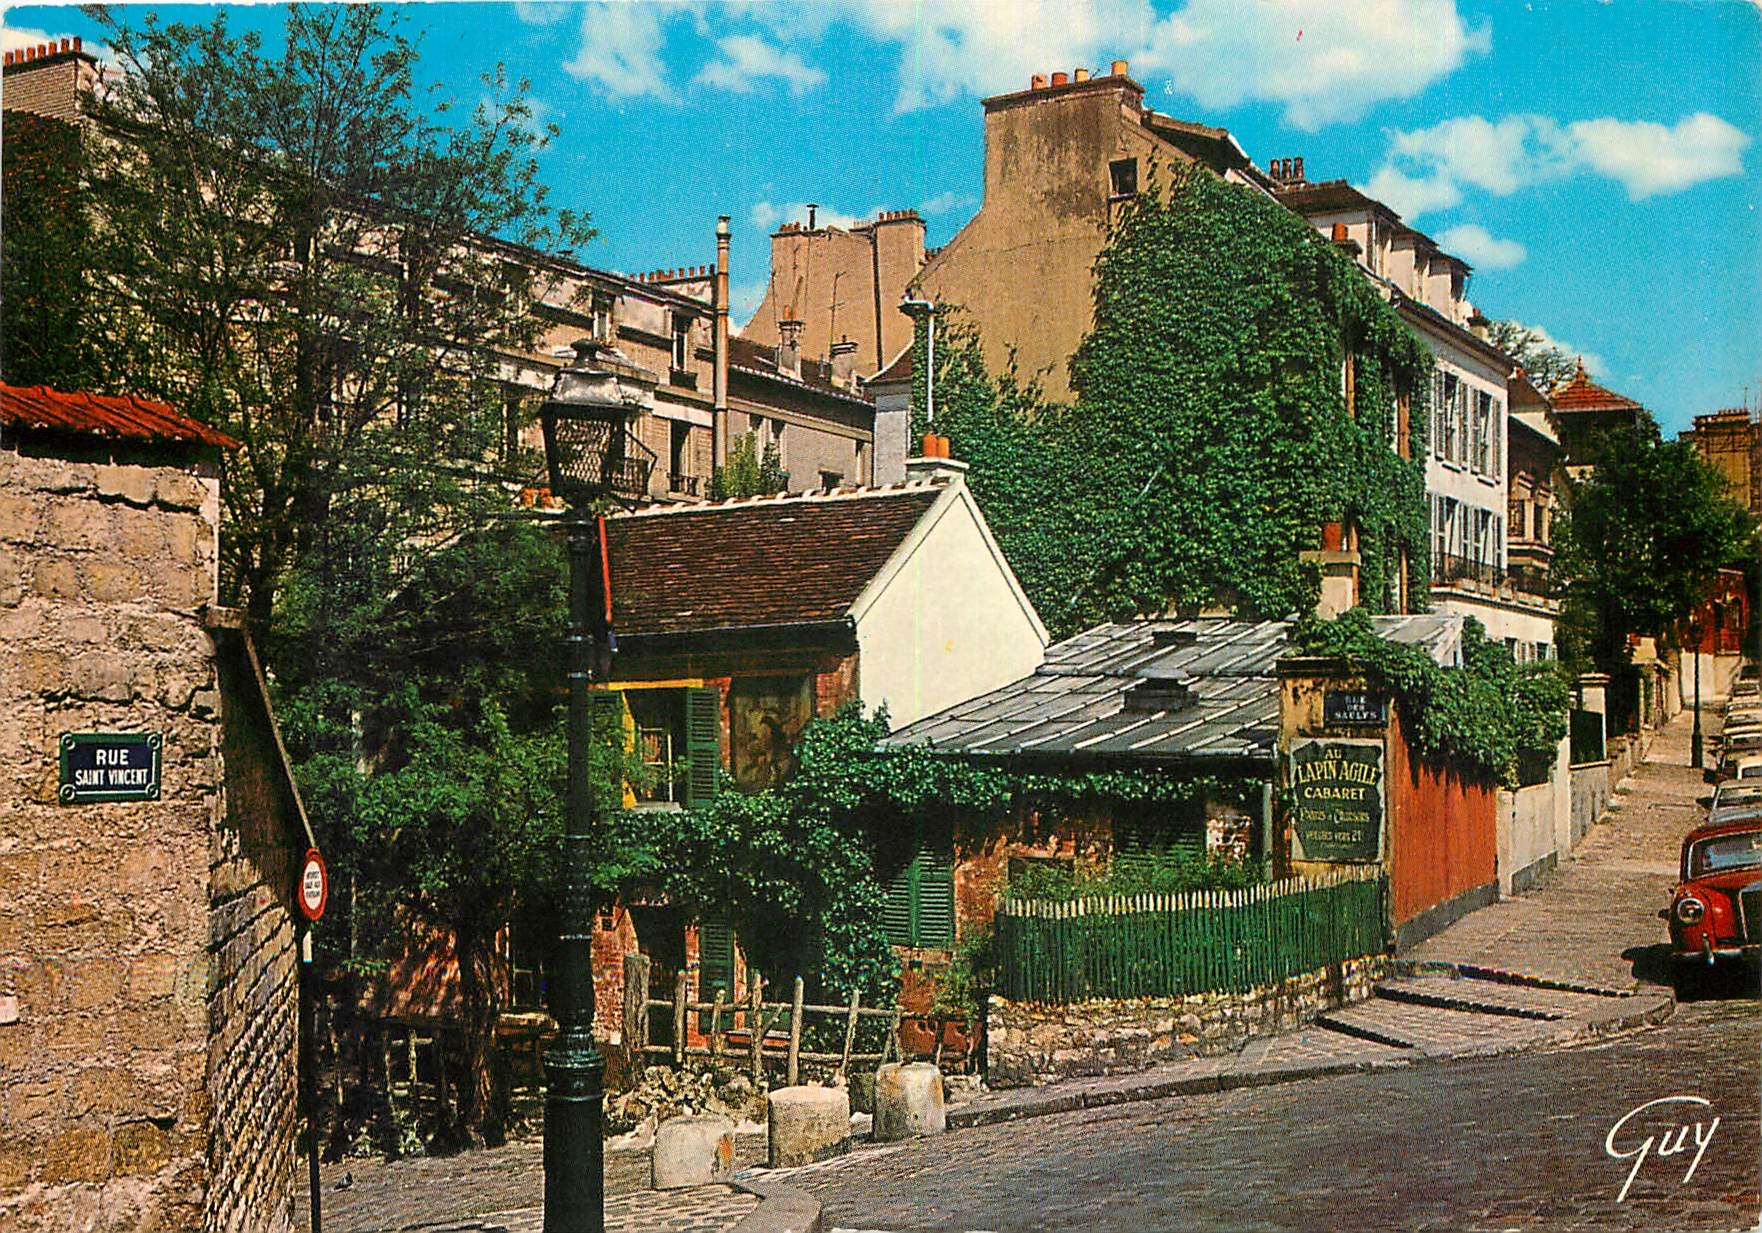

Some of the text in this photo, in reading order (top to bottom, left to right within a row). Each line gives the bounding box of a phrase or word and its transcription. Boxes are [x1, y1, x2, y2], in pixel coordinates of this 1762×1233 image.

[96, 749, 129, 765] RUE
[1325, 749, 1342, 759] AU
[75, 769, 148, 785] SAINT VINCENT
[1297, 759, 1379, 785] LAPIN AGILE
[1304, 787, 1366, 800] CABARET
